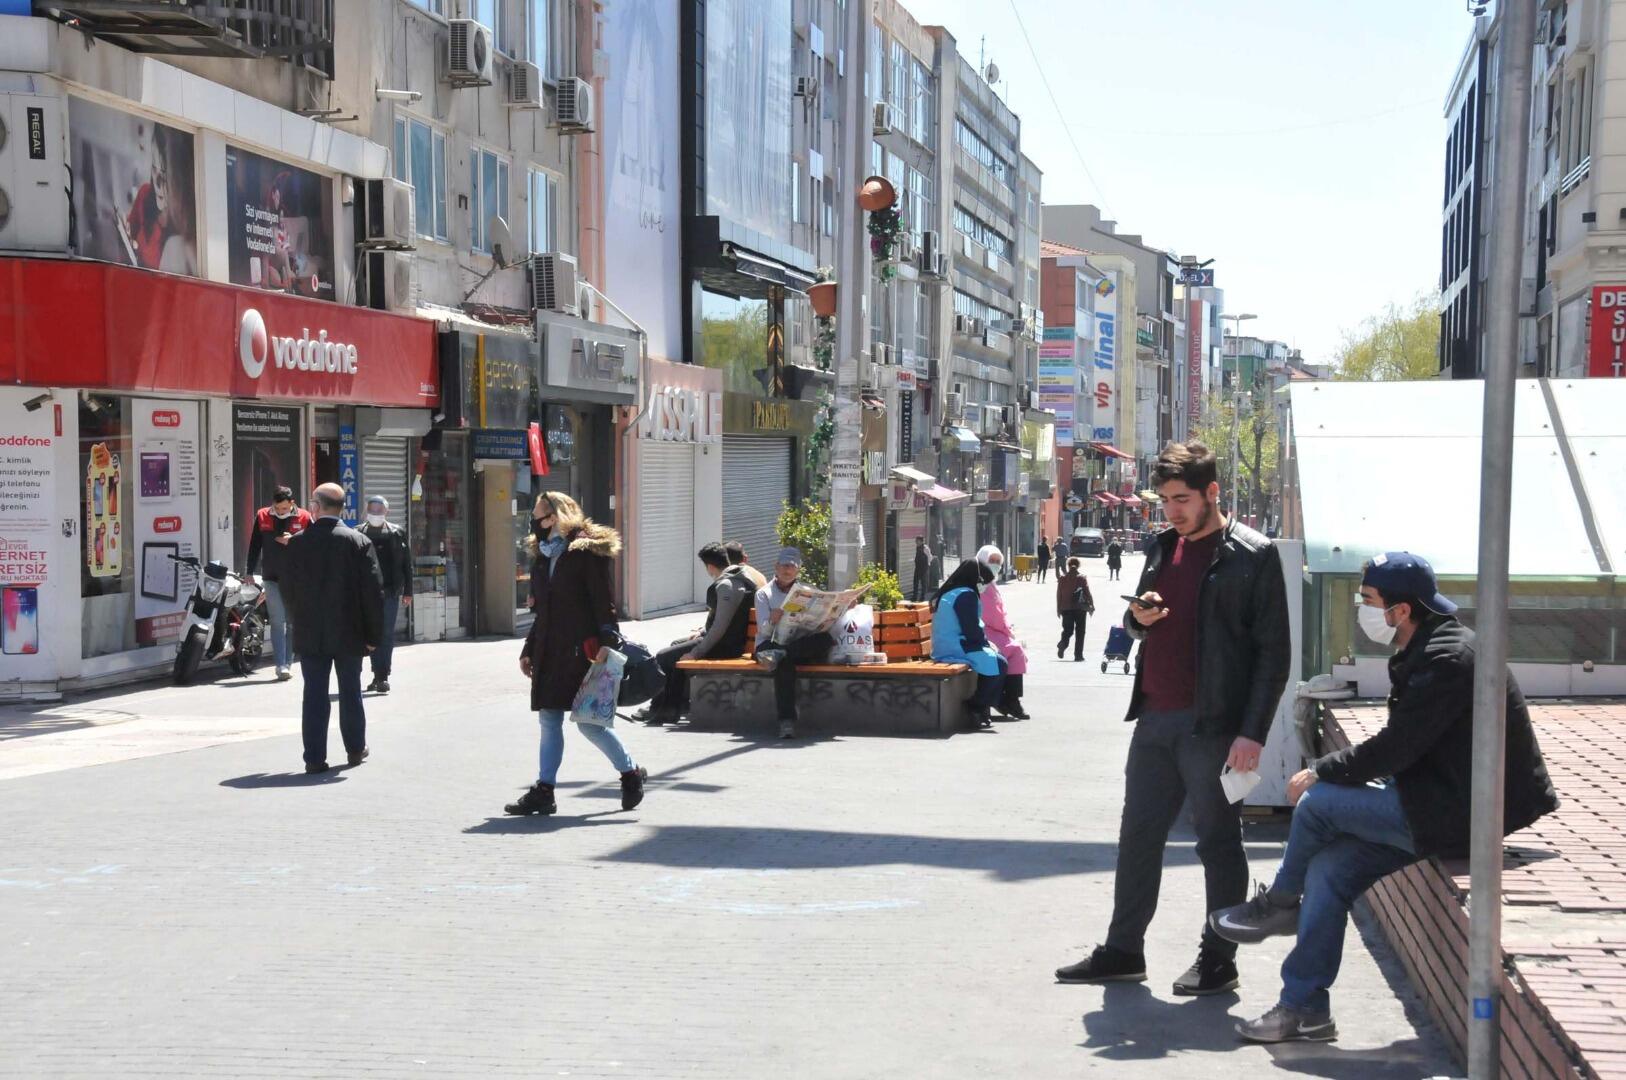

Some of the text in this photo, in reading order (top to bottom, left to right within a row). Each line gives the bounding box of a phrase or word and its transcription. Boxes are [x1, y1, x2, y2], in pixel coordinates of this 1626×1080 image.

[31, 112, 41, 155] REGAL
[255, 208, 279, 224] yormayan
[272, 327, 358, 375] vodafone
[1095, 312, 1114, 370] final
[1096, 383, 1113, 408] vip
[341, 454, 357, 520] TAKIM
